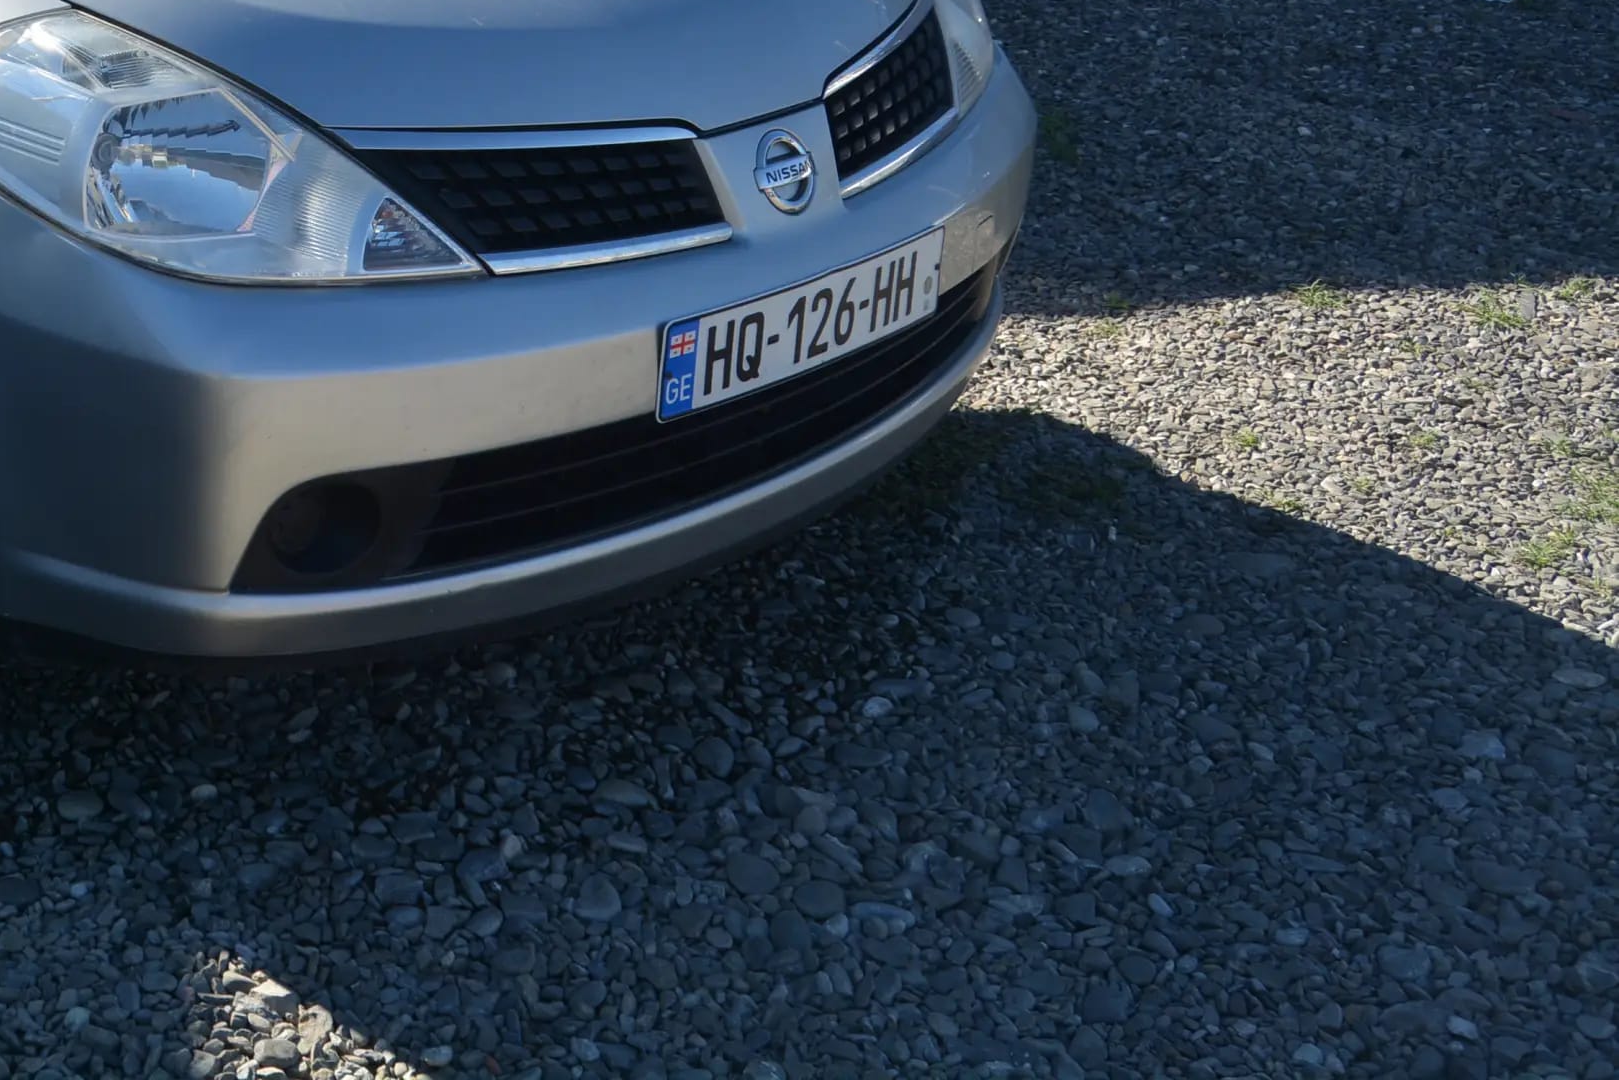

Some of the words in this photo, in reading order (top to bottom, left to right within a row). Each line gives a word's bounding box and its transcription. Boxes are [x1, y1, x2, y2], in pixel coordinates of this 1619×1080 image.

[765, 160, 812, 184] NISSAN
[703, 251, 918, 395] HQ-126-HH
[665, 373, 693, 405] GE
